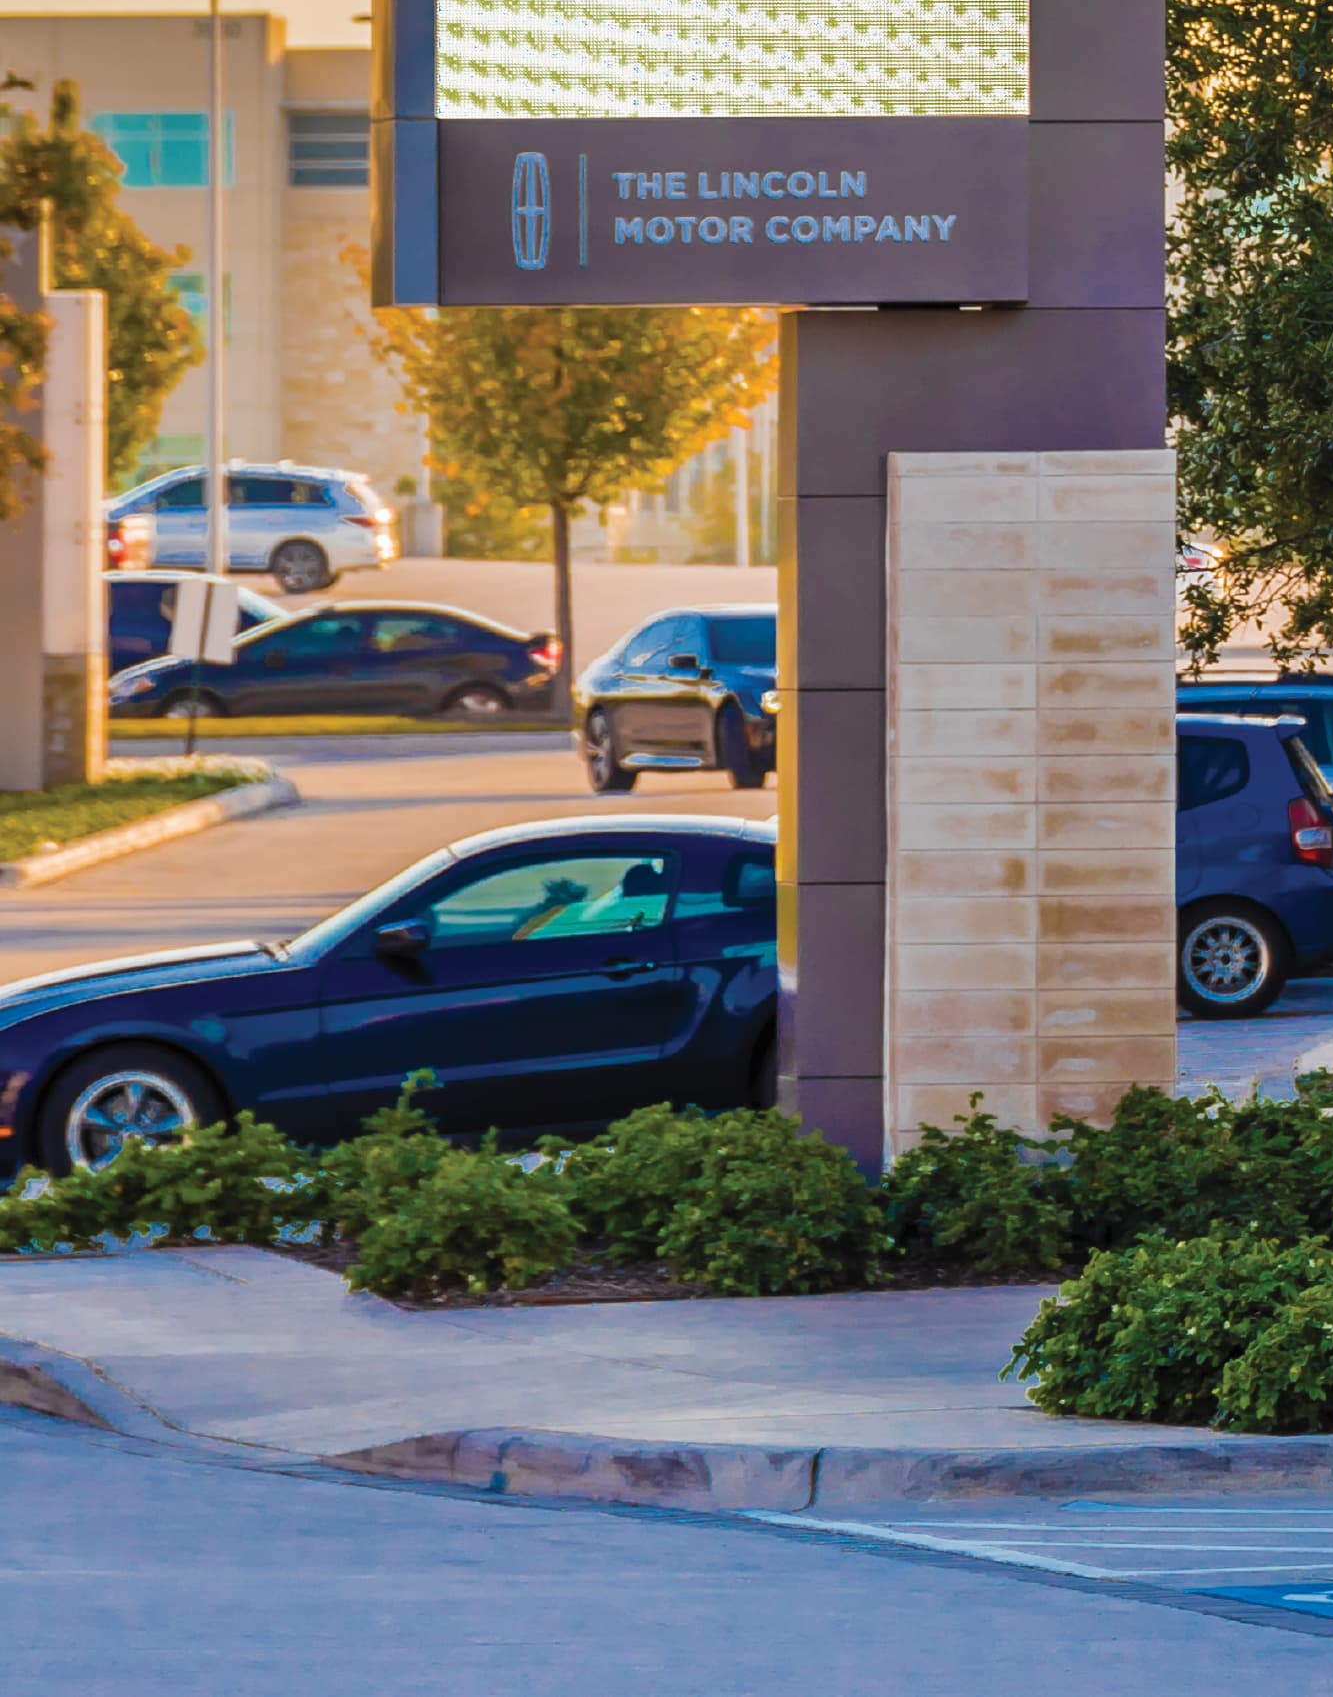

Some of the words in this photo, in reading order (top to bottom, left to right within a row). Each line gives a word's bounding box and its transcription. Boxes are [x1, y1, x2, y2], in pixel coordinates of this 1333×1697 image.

[612, 171, 687, 200] THE
[697, 170, 867, 200] LINCOLN
[613, 215, 754, 244] MOTOR
[764, 213, 957, 244] COMPANY
